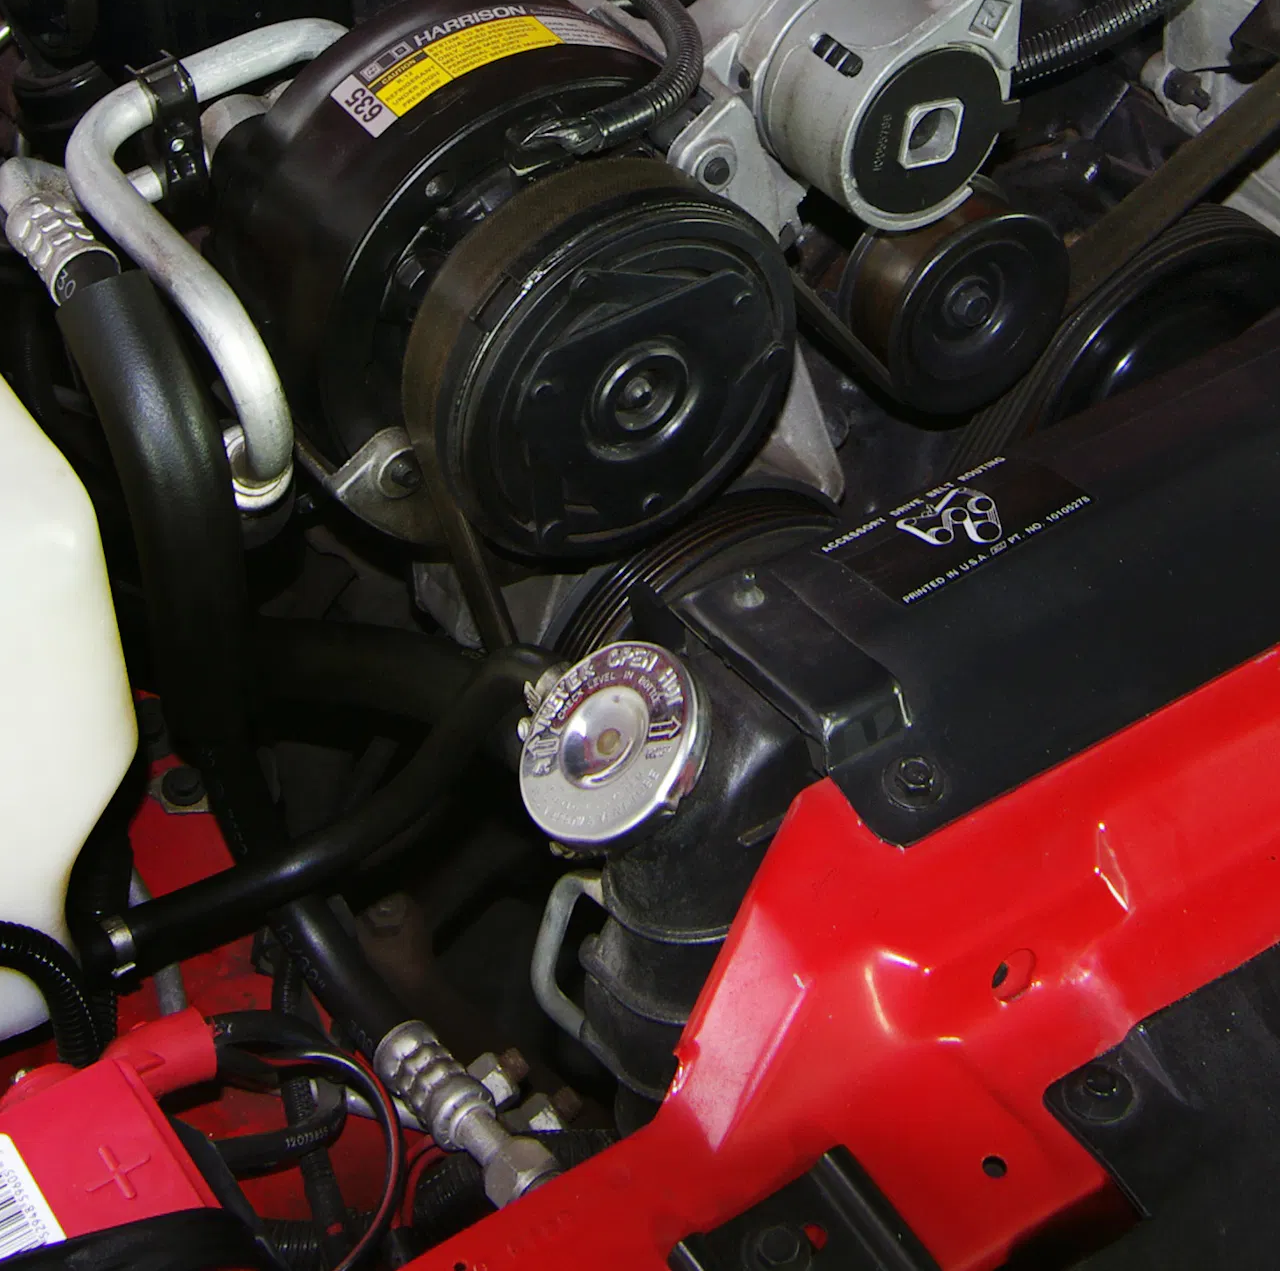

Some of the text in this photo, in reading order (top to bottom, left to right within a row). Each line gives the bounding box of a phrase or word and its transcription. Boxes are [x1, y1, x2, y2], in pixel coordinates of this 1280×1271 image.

[413, 5, 527, 47] HARRISON
[427, 34, 460, 53] SYSTEM
[462, 29, 473, 38] TO
[381, 59, 417, 85] CAUTION
[384, 65, 435, 103] REFRIGERANT
[392, 69, 440, 107] UNDER HIGH
[344, 88, 383, 123] 635
[402, 76, 442, 109] PRESSURE
[821, 456, 1006, 553] ACCESSORY DRIVE BELT ROUTING
[902, 576, 945, 604] PRINTED
[946, 568, 960, 579] IN
[608, 646, 659, 672] OPEN
[557, 671, 660, 721] CHECK LEVEL IN BOTTLE
